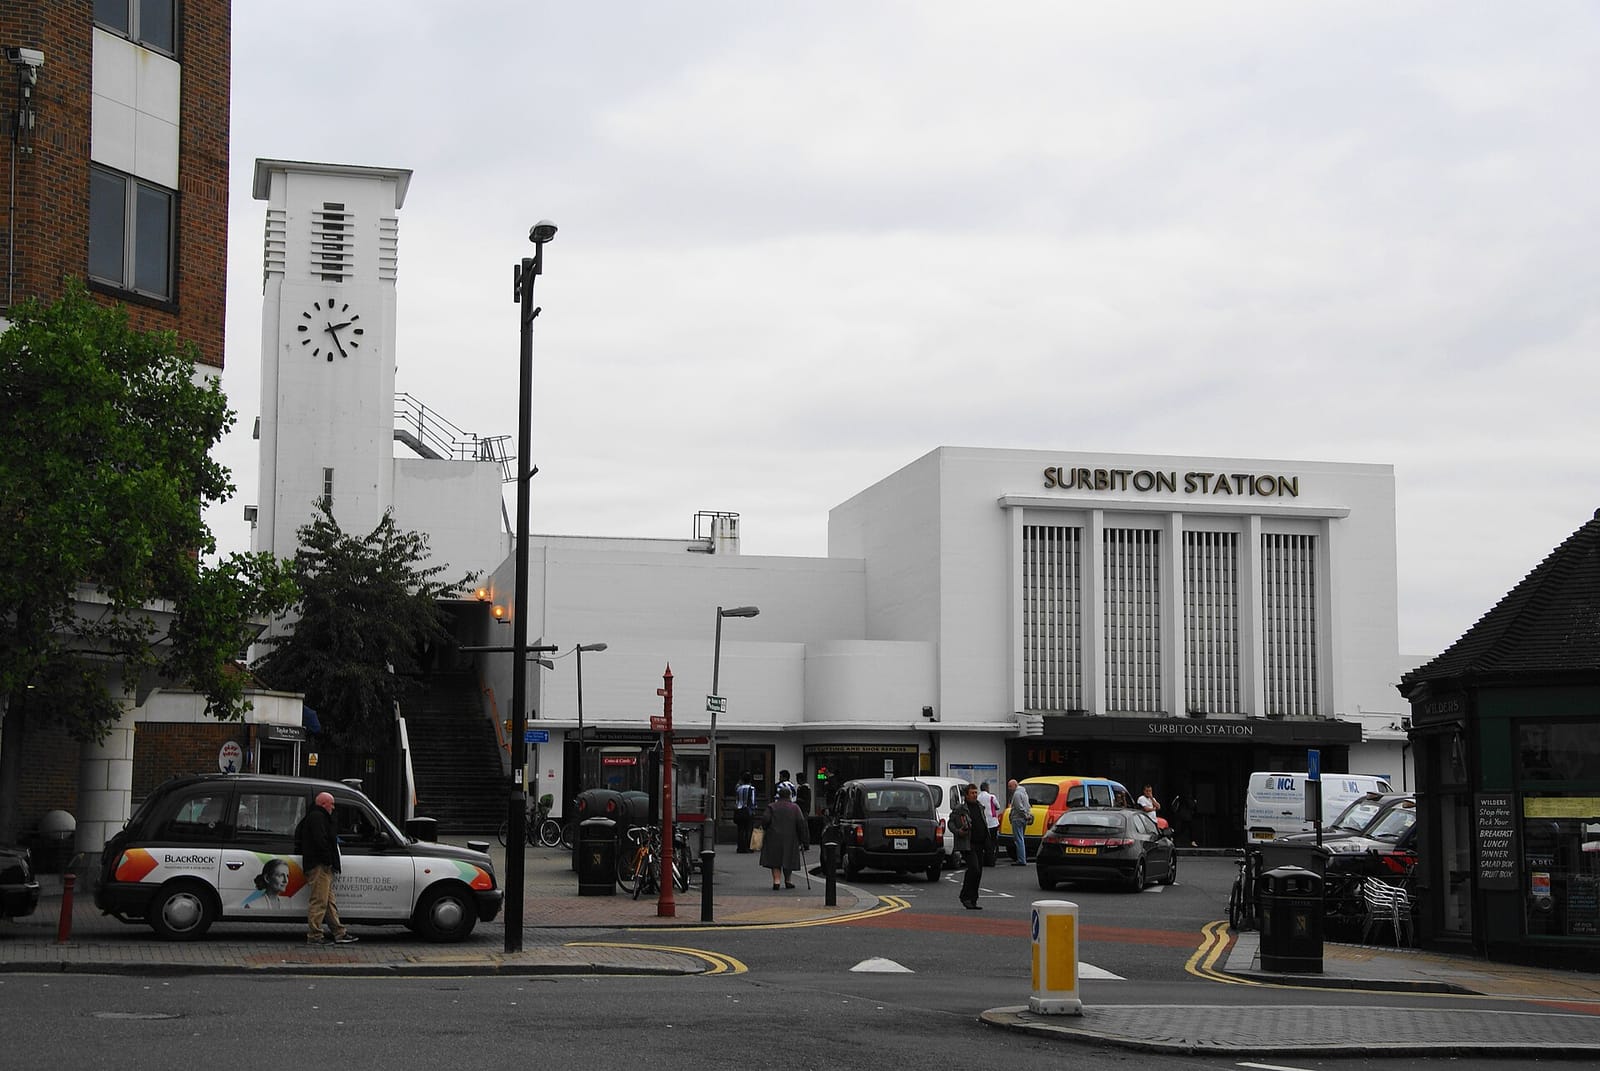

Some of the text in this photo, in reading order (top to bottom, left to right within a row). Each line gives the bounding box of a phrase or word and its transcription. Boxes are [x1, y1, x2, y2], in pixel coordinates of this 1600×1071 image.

[1043, 466, 1299, 498] SURBITON STATION
[1148, 723, 1253, 736] SURBITON STATION
[1277, 778, 1296, 791] NCL
[1348, 781, 1360, 794] NCL
[1480, 808, 1495, 817] Stop
[1479, 830, 1514, 838] BREAKFAST
[1483, 840, 1508, 848] LUNCH
[1481, 850, 1508, 858] DINNER
[1480, 860, 1514, 868] SALAD BOX
[1481, 870, 1512, 878] FRUIT BOX
